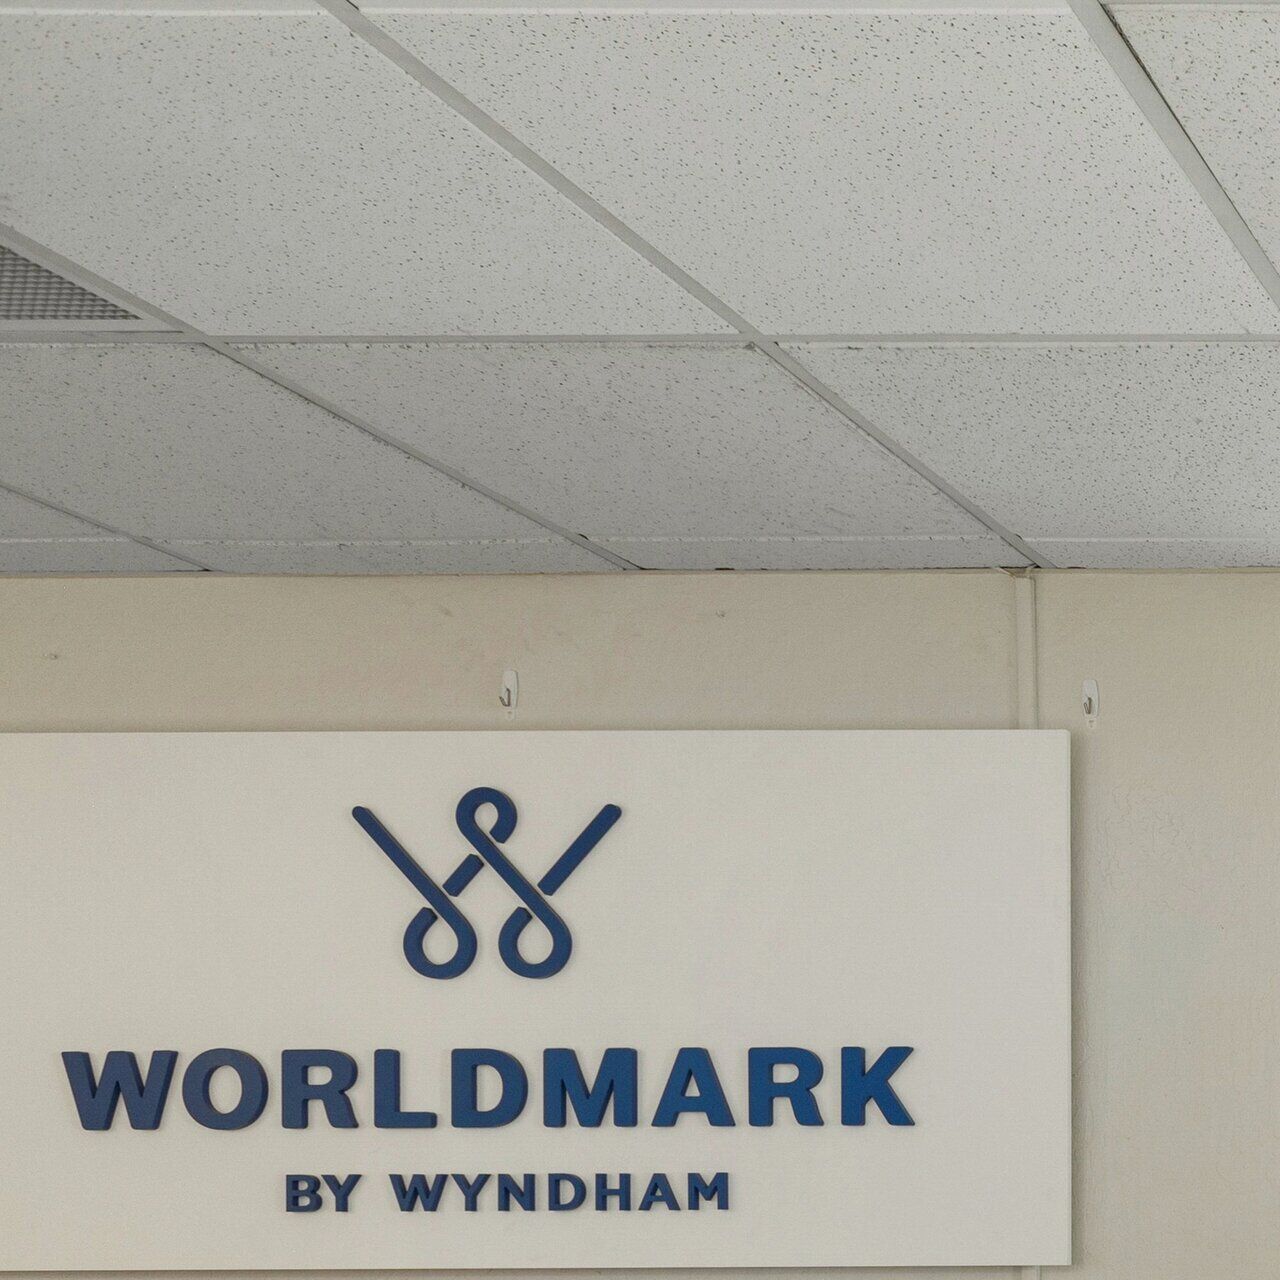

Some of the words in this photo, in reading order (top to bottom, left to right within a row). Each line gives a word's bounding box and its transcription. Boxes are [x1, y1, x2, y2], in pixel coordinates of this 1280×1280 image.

[61, 1046, 917, 1131] WORLDMARK
[284, 1172, 362, 1214] BY
[389, 1171, 730, 1213] WYNDHAM
